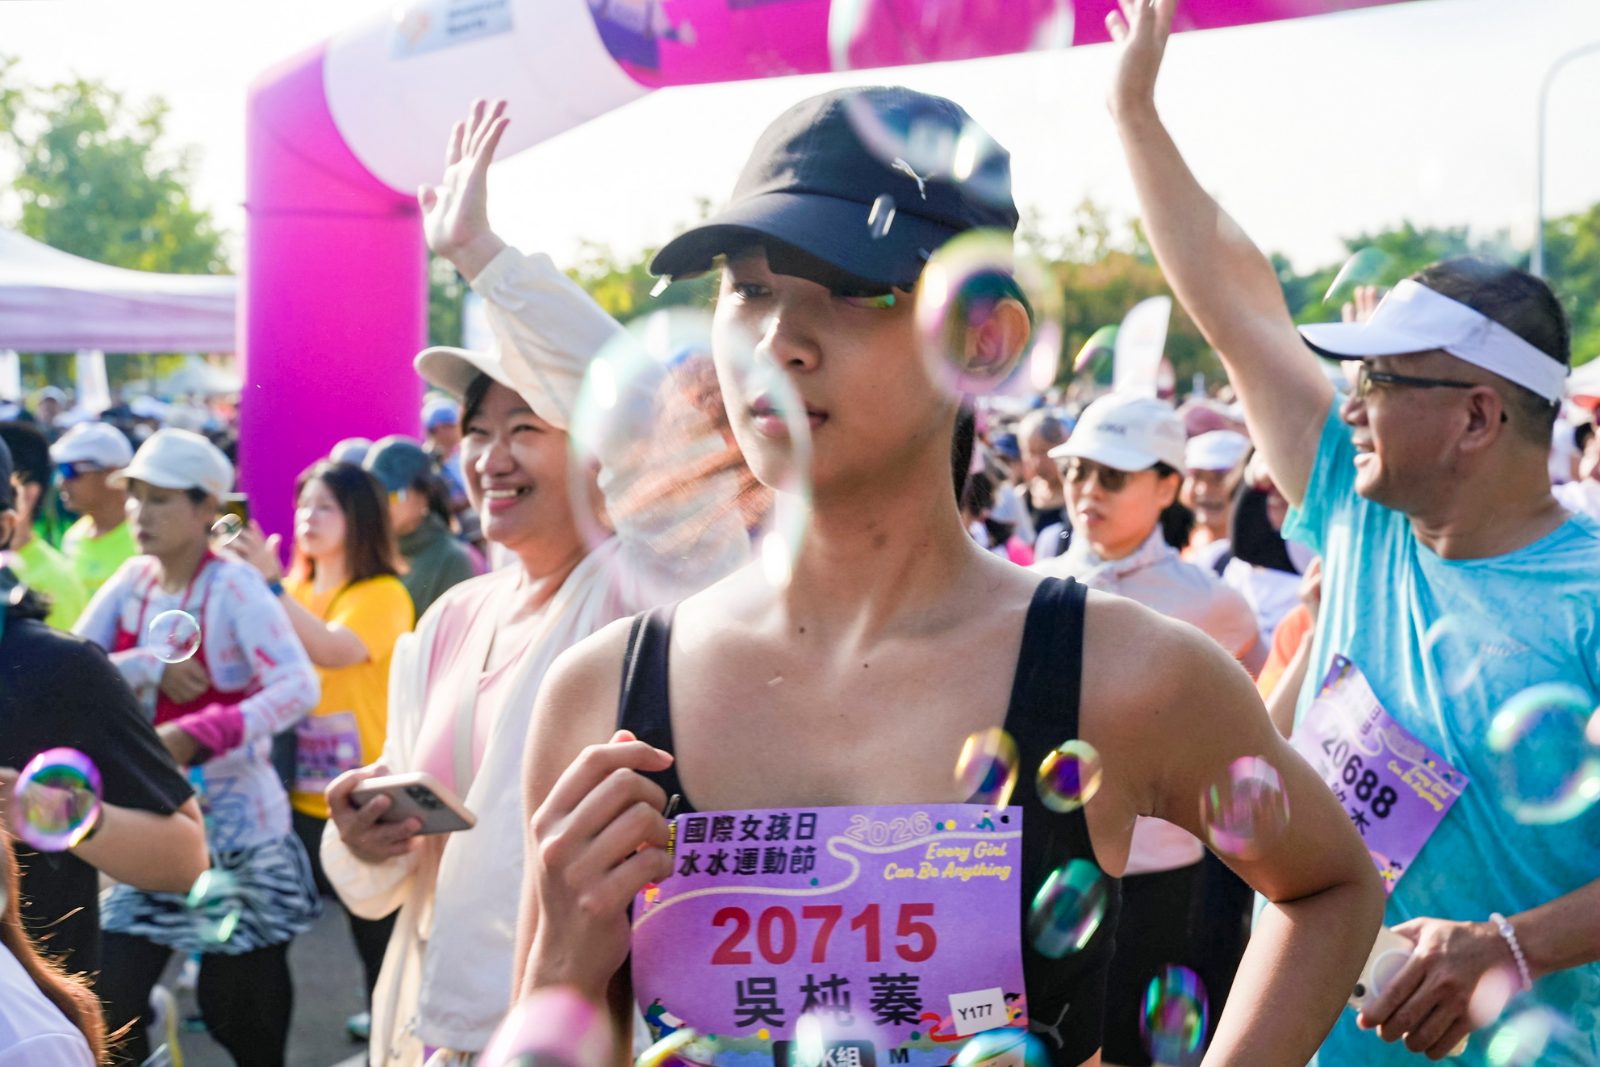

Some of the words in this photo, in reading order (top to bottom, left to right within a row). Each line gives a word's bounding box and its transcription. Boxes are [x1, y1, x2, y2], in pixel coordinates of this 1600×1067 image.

[1322, 727, 1398, 819] 20688
[683, 812, 818, 844] 國際女孩日
[843, 810, 933, 846] 2026
[678, 845, 817, 877] 水水運動節
[925, 841, 970, 862] Every
[973, 841, 1007, 858] Girl
[883, 862, 915, 880] Can
[916, 860, 939, 880] Be
[941, 861, 1012, 882] Anything
[709, 902, 938, 965] 20715
[957, 1003, 993, 1021] Y177
[890, 1048, 909, 1064] M
